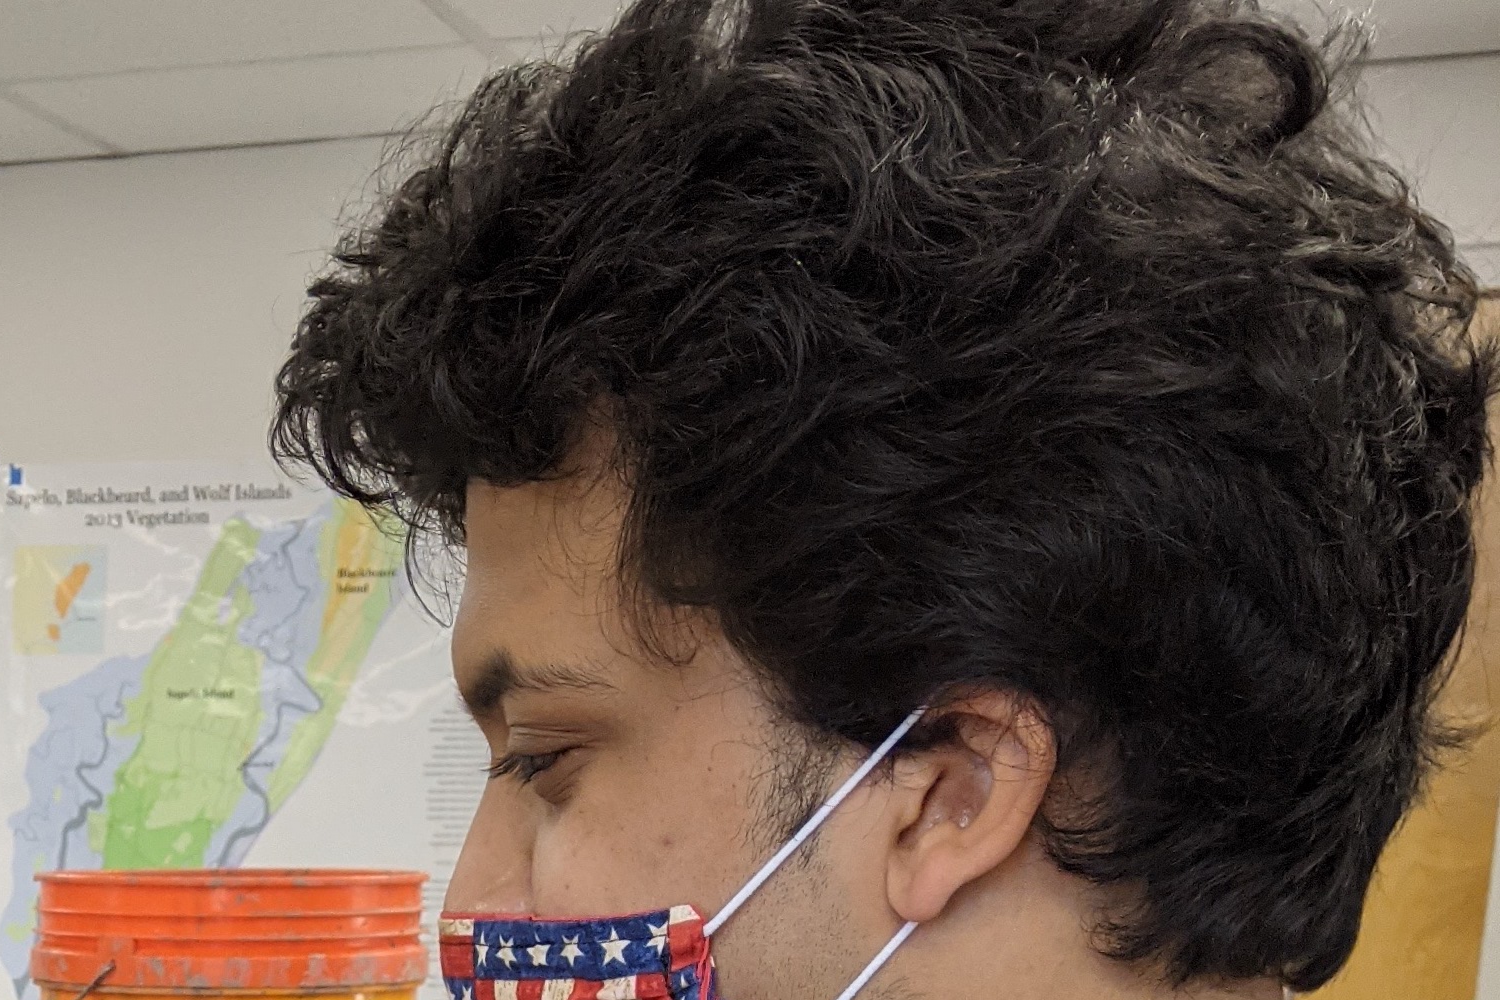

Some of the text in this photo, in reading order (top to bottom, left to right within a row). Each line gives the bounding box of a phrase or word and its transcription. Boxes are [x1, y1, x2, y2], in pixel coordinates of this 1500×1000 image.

[159, 484, 190, 502] and
[192, 483, 234, 501] Wolf
[235, 481, 293, 501] Islands
[126, 508, 209, 528] Vegetation
